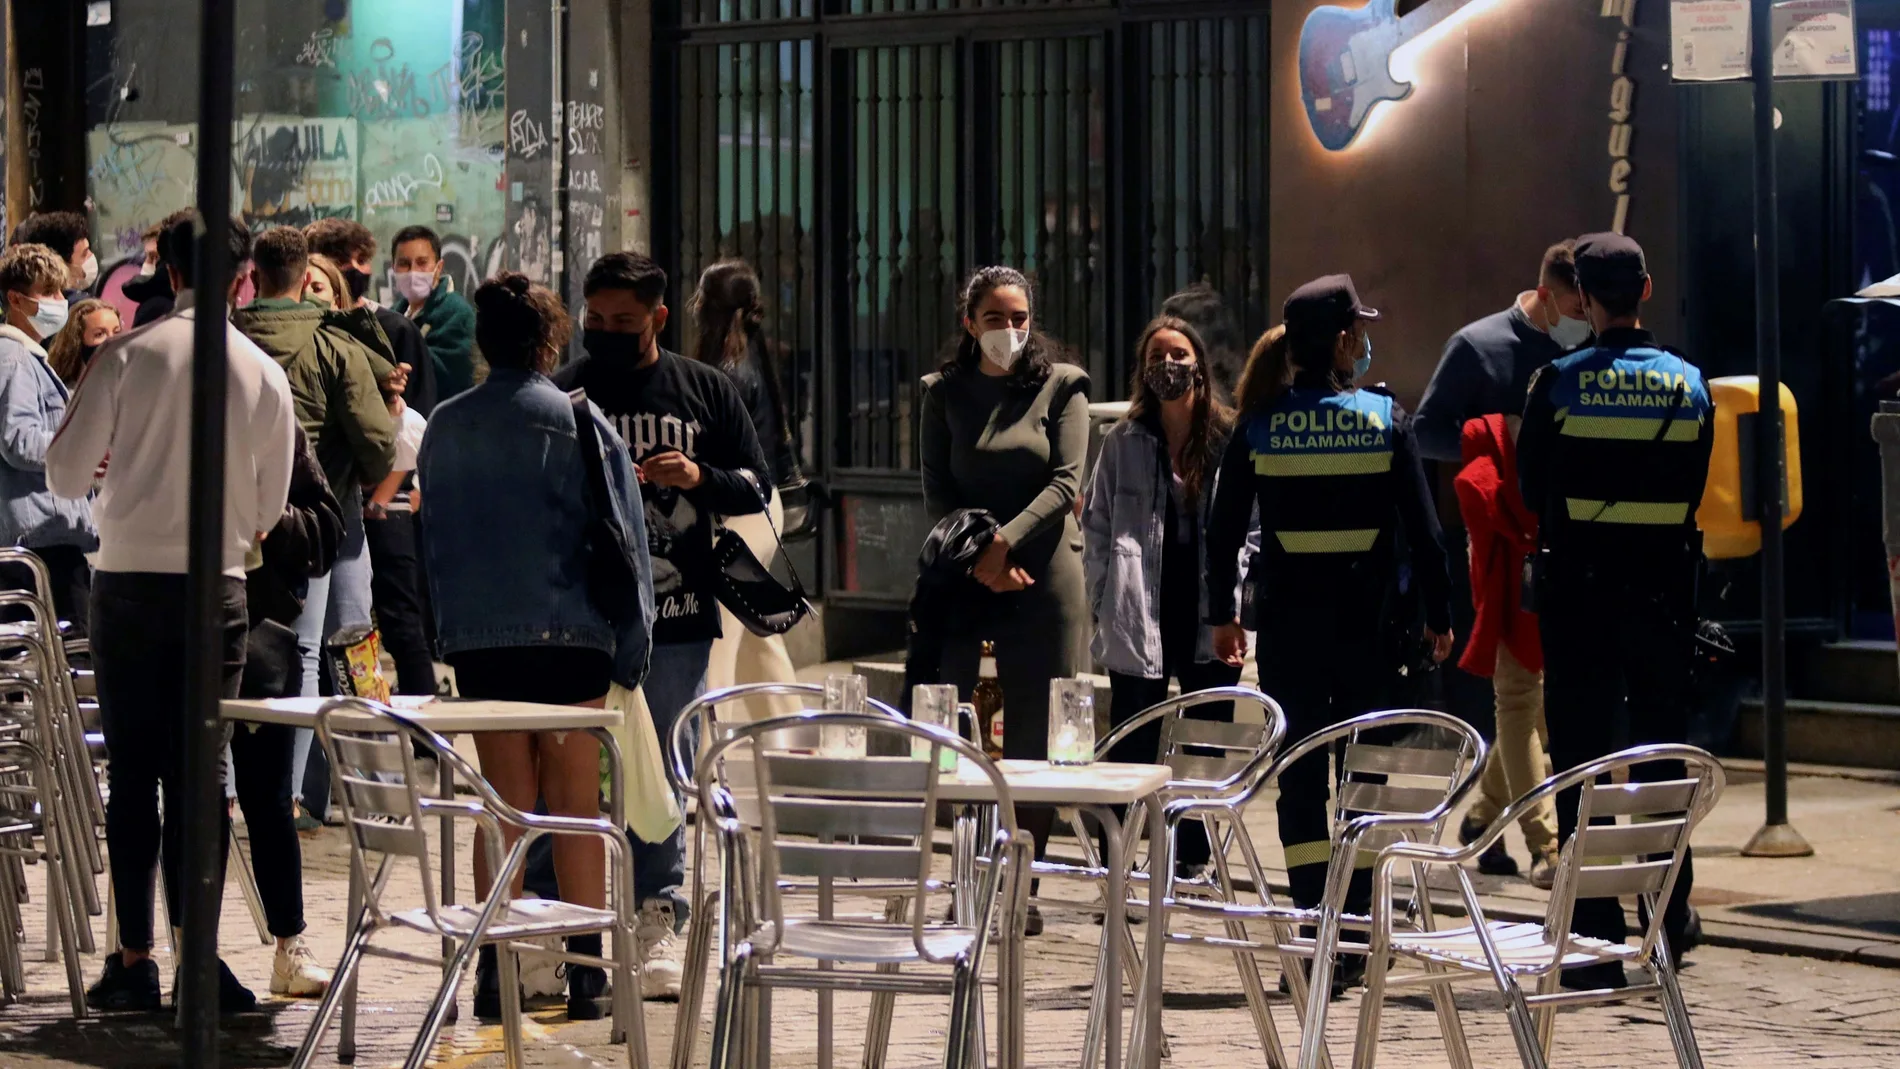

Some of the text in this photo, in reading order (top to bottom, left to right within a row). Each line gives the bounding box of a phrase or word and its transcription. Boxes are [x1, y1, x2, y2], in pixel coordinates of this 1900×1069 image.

[242, 124, 350, 161] ALUILA
[1579, 369, 1692, 393] POLICIA
[1270, 409, 1386, 433] POLICIA
[1270, 433, 1386, 449] SALAMANCA
[662, 596, 680, 619] On
[680, 592, 700, 617] Me
